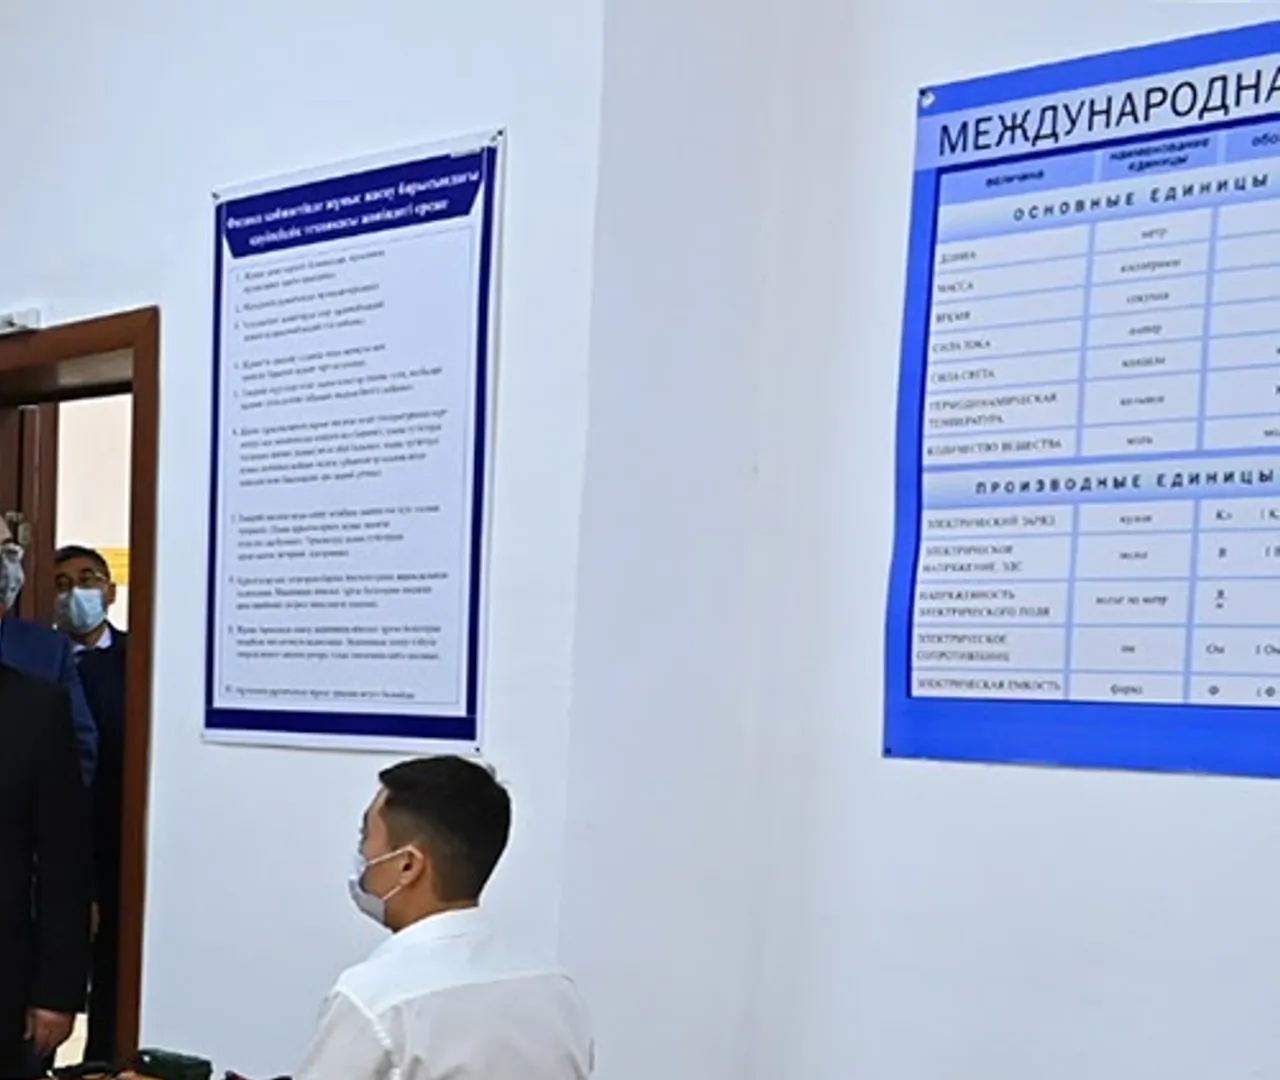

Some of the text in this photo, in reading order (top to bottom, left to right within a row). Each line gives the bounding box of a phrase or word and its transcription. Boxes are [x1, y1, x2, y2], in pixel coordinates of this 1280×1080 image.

[1013, 174, 1269, 222] ОСНОВНЫЕ ЕДИНИЦЫ
[975, 469, 1274, 495] ПРОИЗВОДНЫЕ ЕДИНИЦЫ
